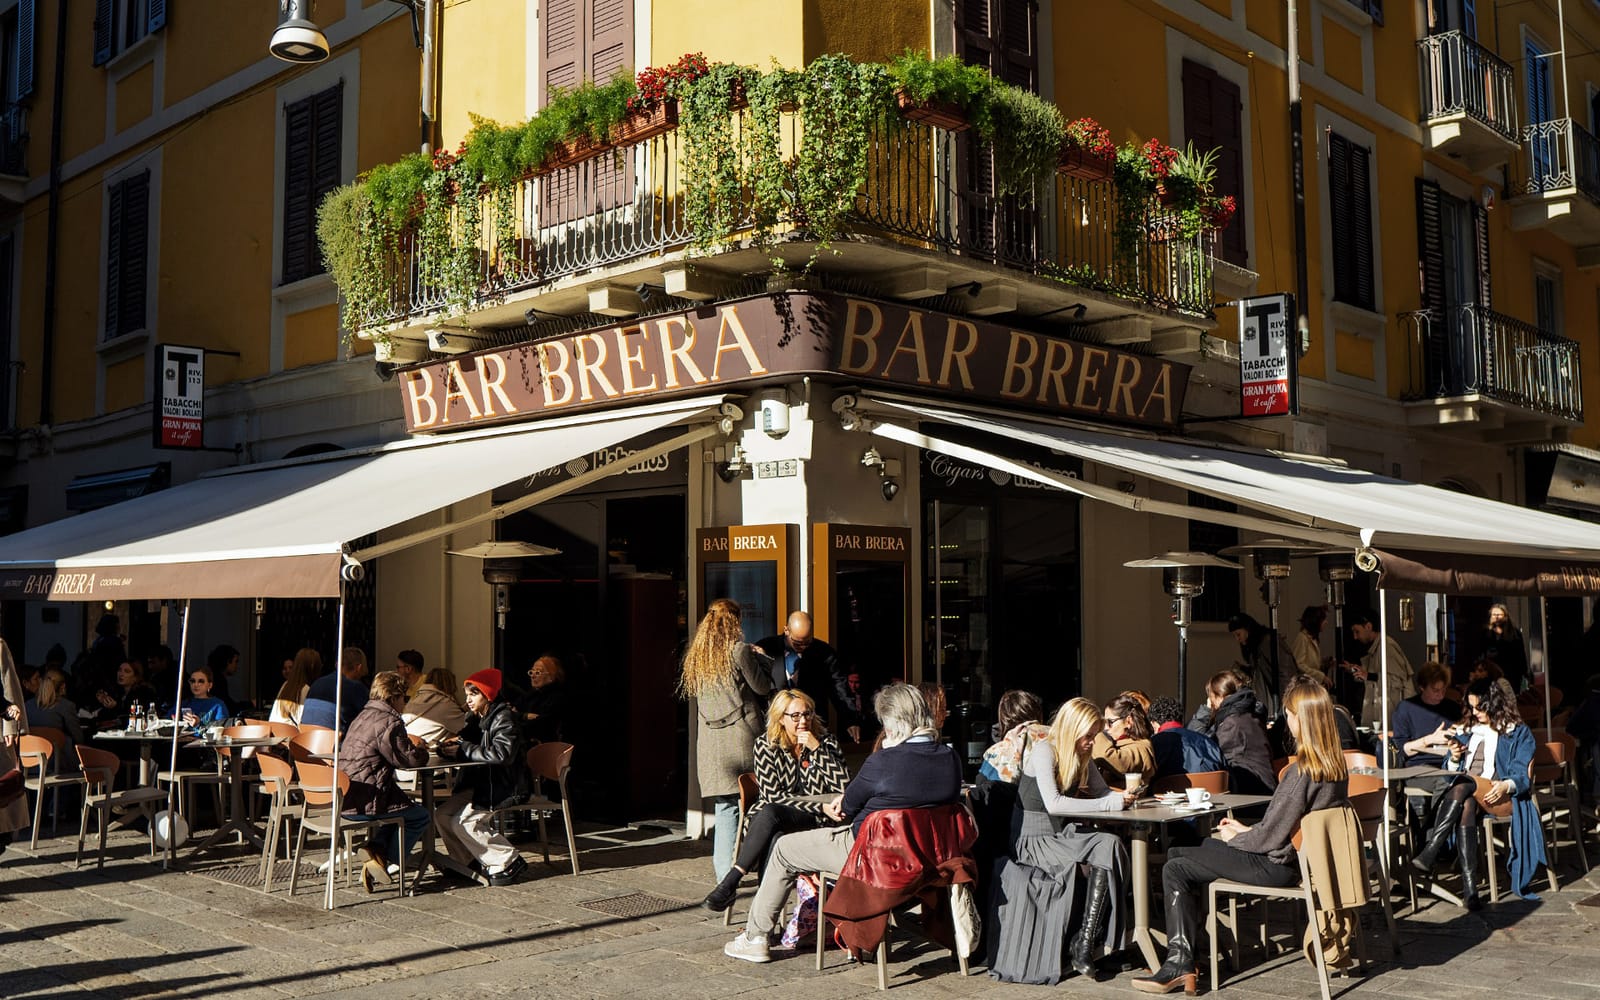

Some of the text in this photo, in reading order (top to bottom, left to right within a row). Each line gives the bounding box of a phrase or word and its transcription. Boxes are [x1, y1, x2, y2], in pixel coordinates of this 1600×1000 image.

[1246, 302, 1280, 356] T
[405, 305, 768, 430] BAR BRERA
[838, 299, 1174, 424] BAR BRERA
[1243, 357, 1286, 370] TABACCHI
[168, 352, 198, 396] T
[1243, 371, 1263, 380] VALORI
[1243, 386, 1264, 396] GRAN
[164, 398, 201, 408] TABACCHI
[1253, 398, 1259, 407] il
[162, 420, 181, 429] GRAN
[765, 463, 771, 472] S
[784, 462, 790, 470] S
[925, 450, 984, 487] Cigars
[703, 535, 778, 551] BAR BRERA
[835, 534, 905, 550] BAR BRERA
[24, 574, 52, 594] BAR
[53, 573, 96, 594] BRERA
[1561, 566, 1587, 590] BAR
